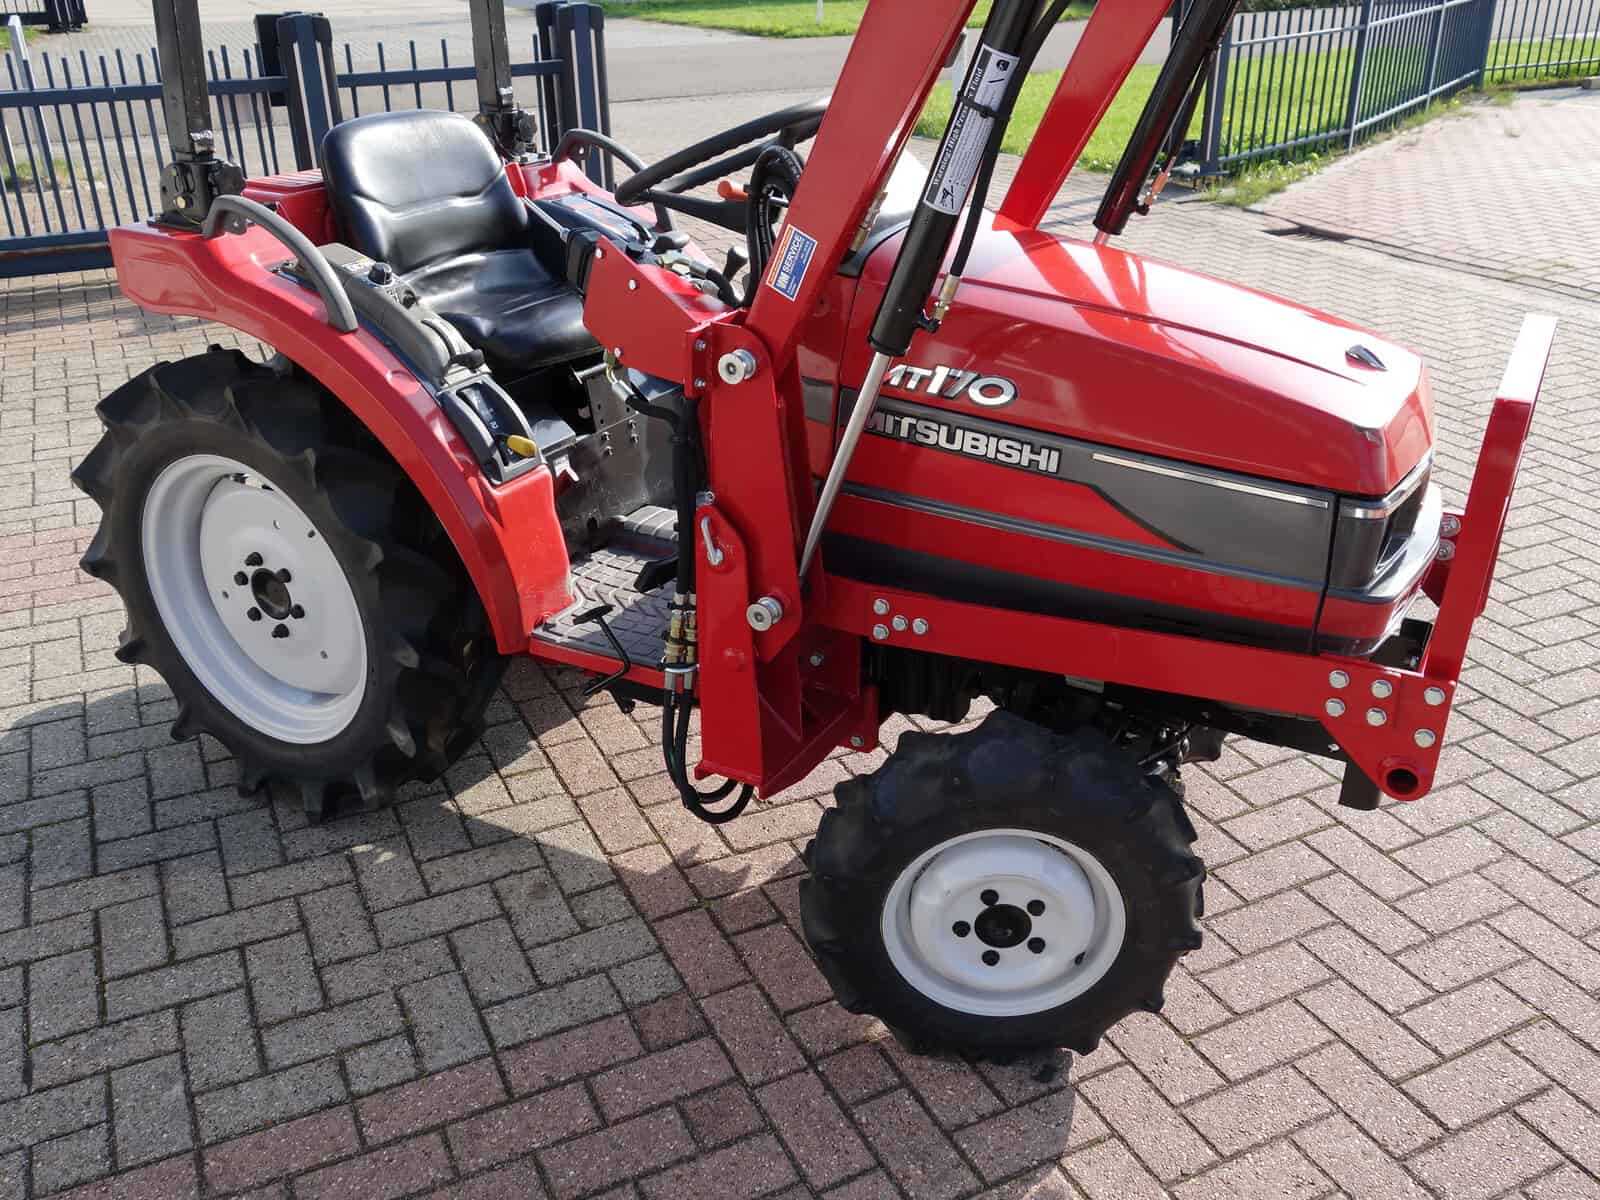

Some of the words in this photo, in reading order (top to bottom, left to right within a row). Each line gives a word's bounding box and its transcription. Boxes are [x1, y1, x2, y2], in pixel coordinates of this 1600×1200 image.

[948, 127, 961, 148] High
[970, 67, 983, 91] Fluid
[782, 231, 802, 273] SERVICE
